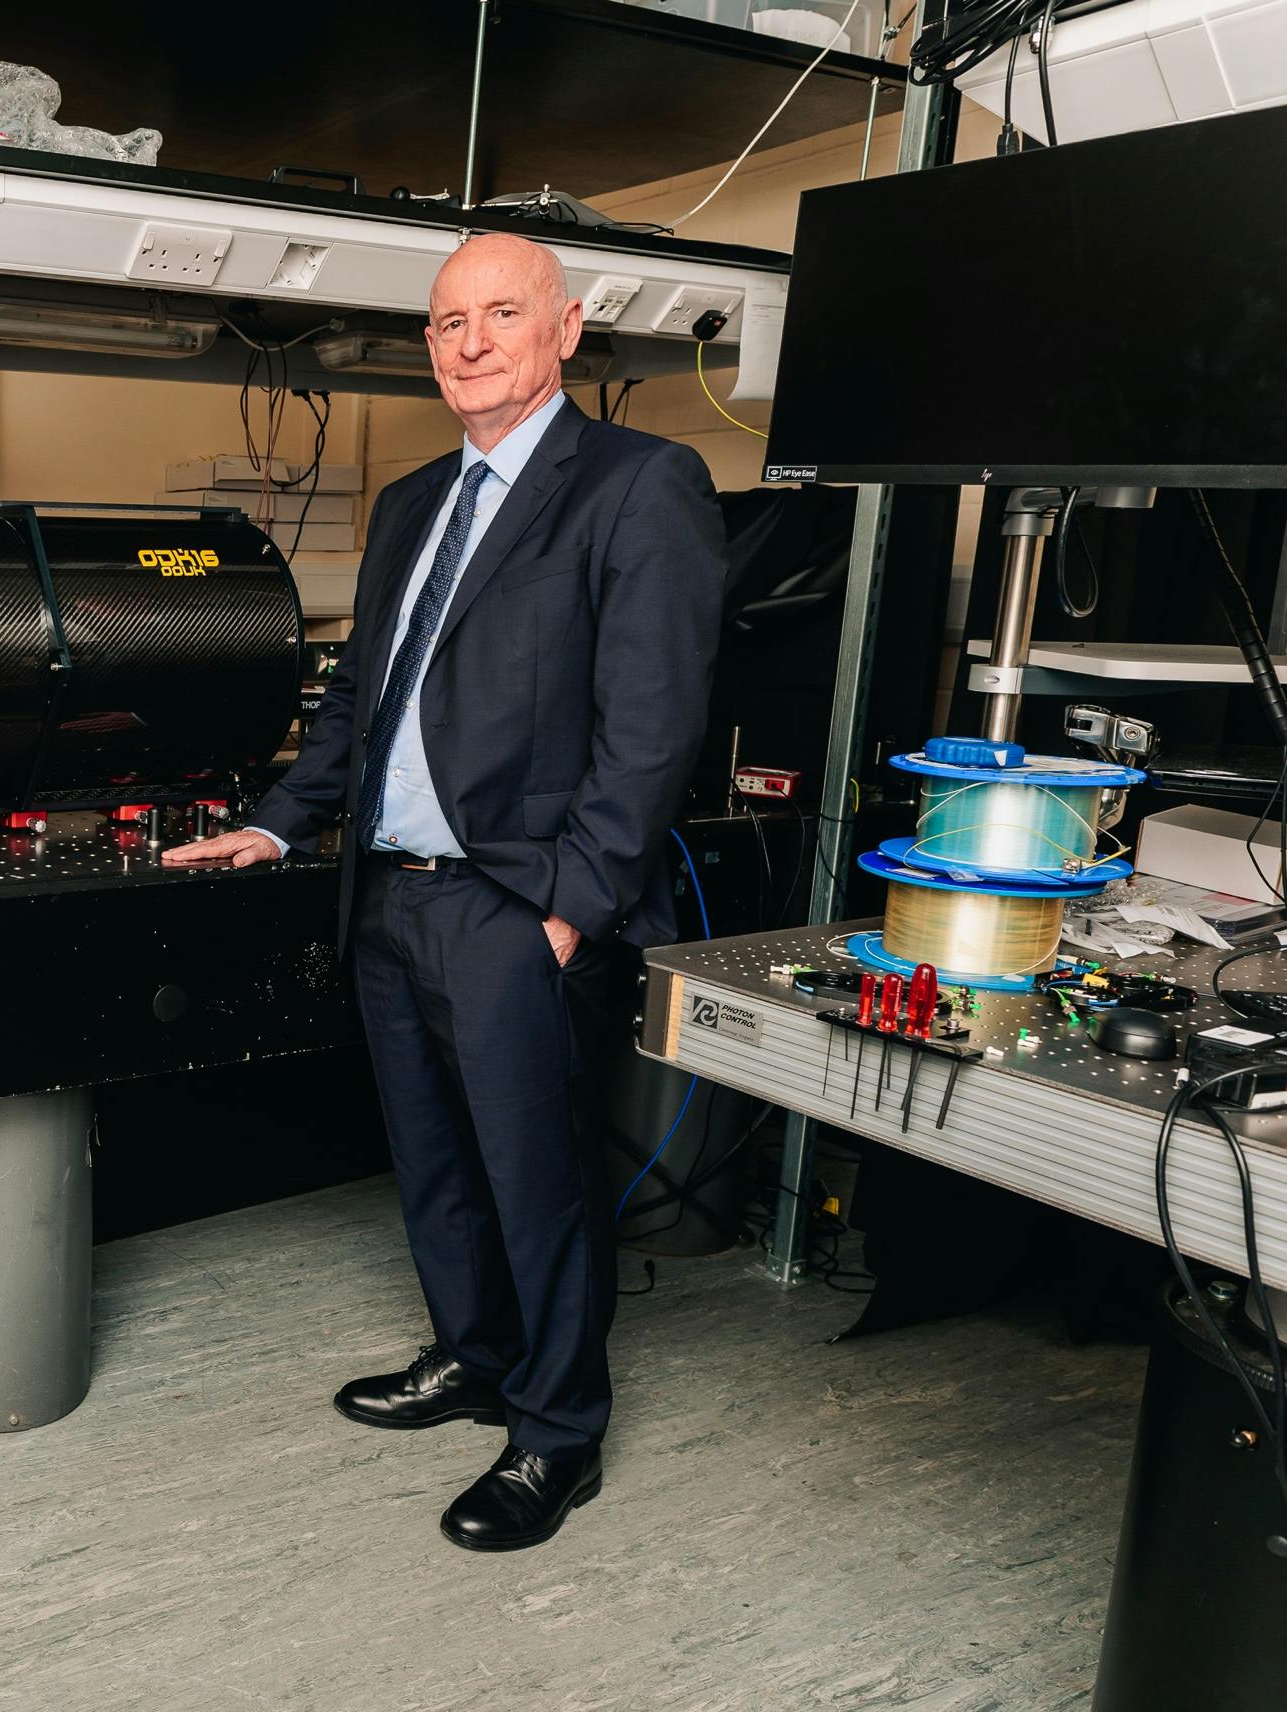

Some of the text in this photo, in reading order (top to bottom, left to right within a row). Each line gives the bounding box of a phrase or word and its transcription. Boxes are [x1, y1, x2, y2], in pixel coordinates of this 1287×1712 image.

[782, 469, 815, 478] HP Eye Ease
[138, 548, 219, 567] ODK16
[721, 1004, 755, 1019] PHOTON
[720, 1012, 756, 1029] CONTROL
